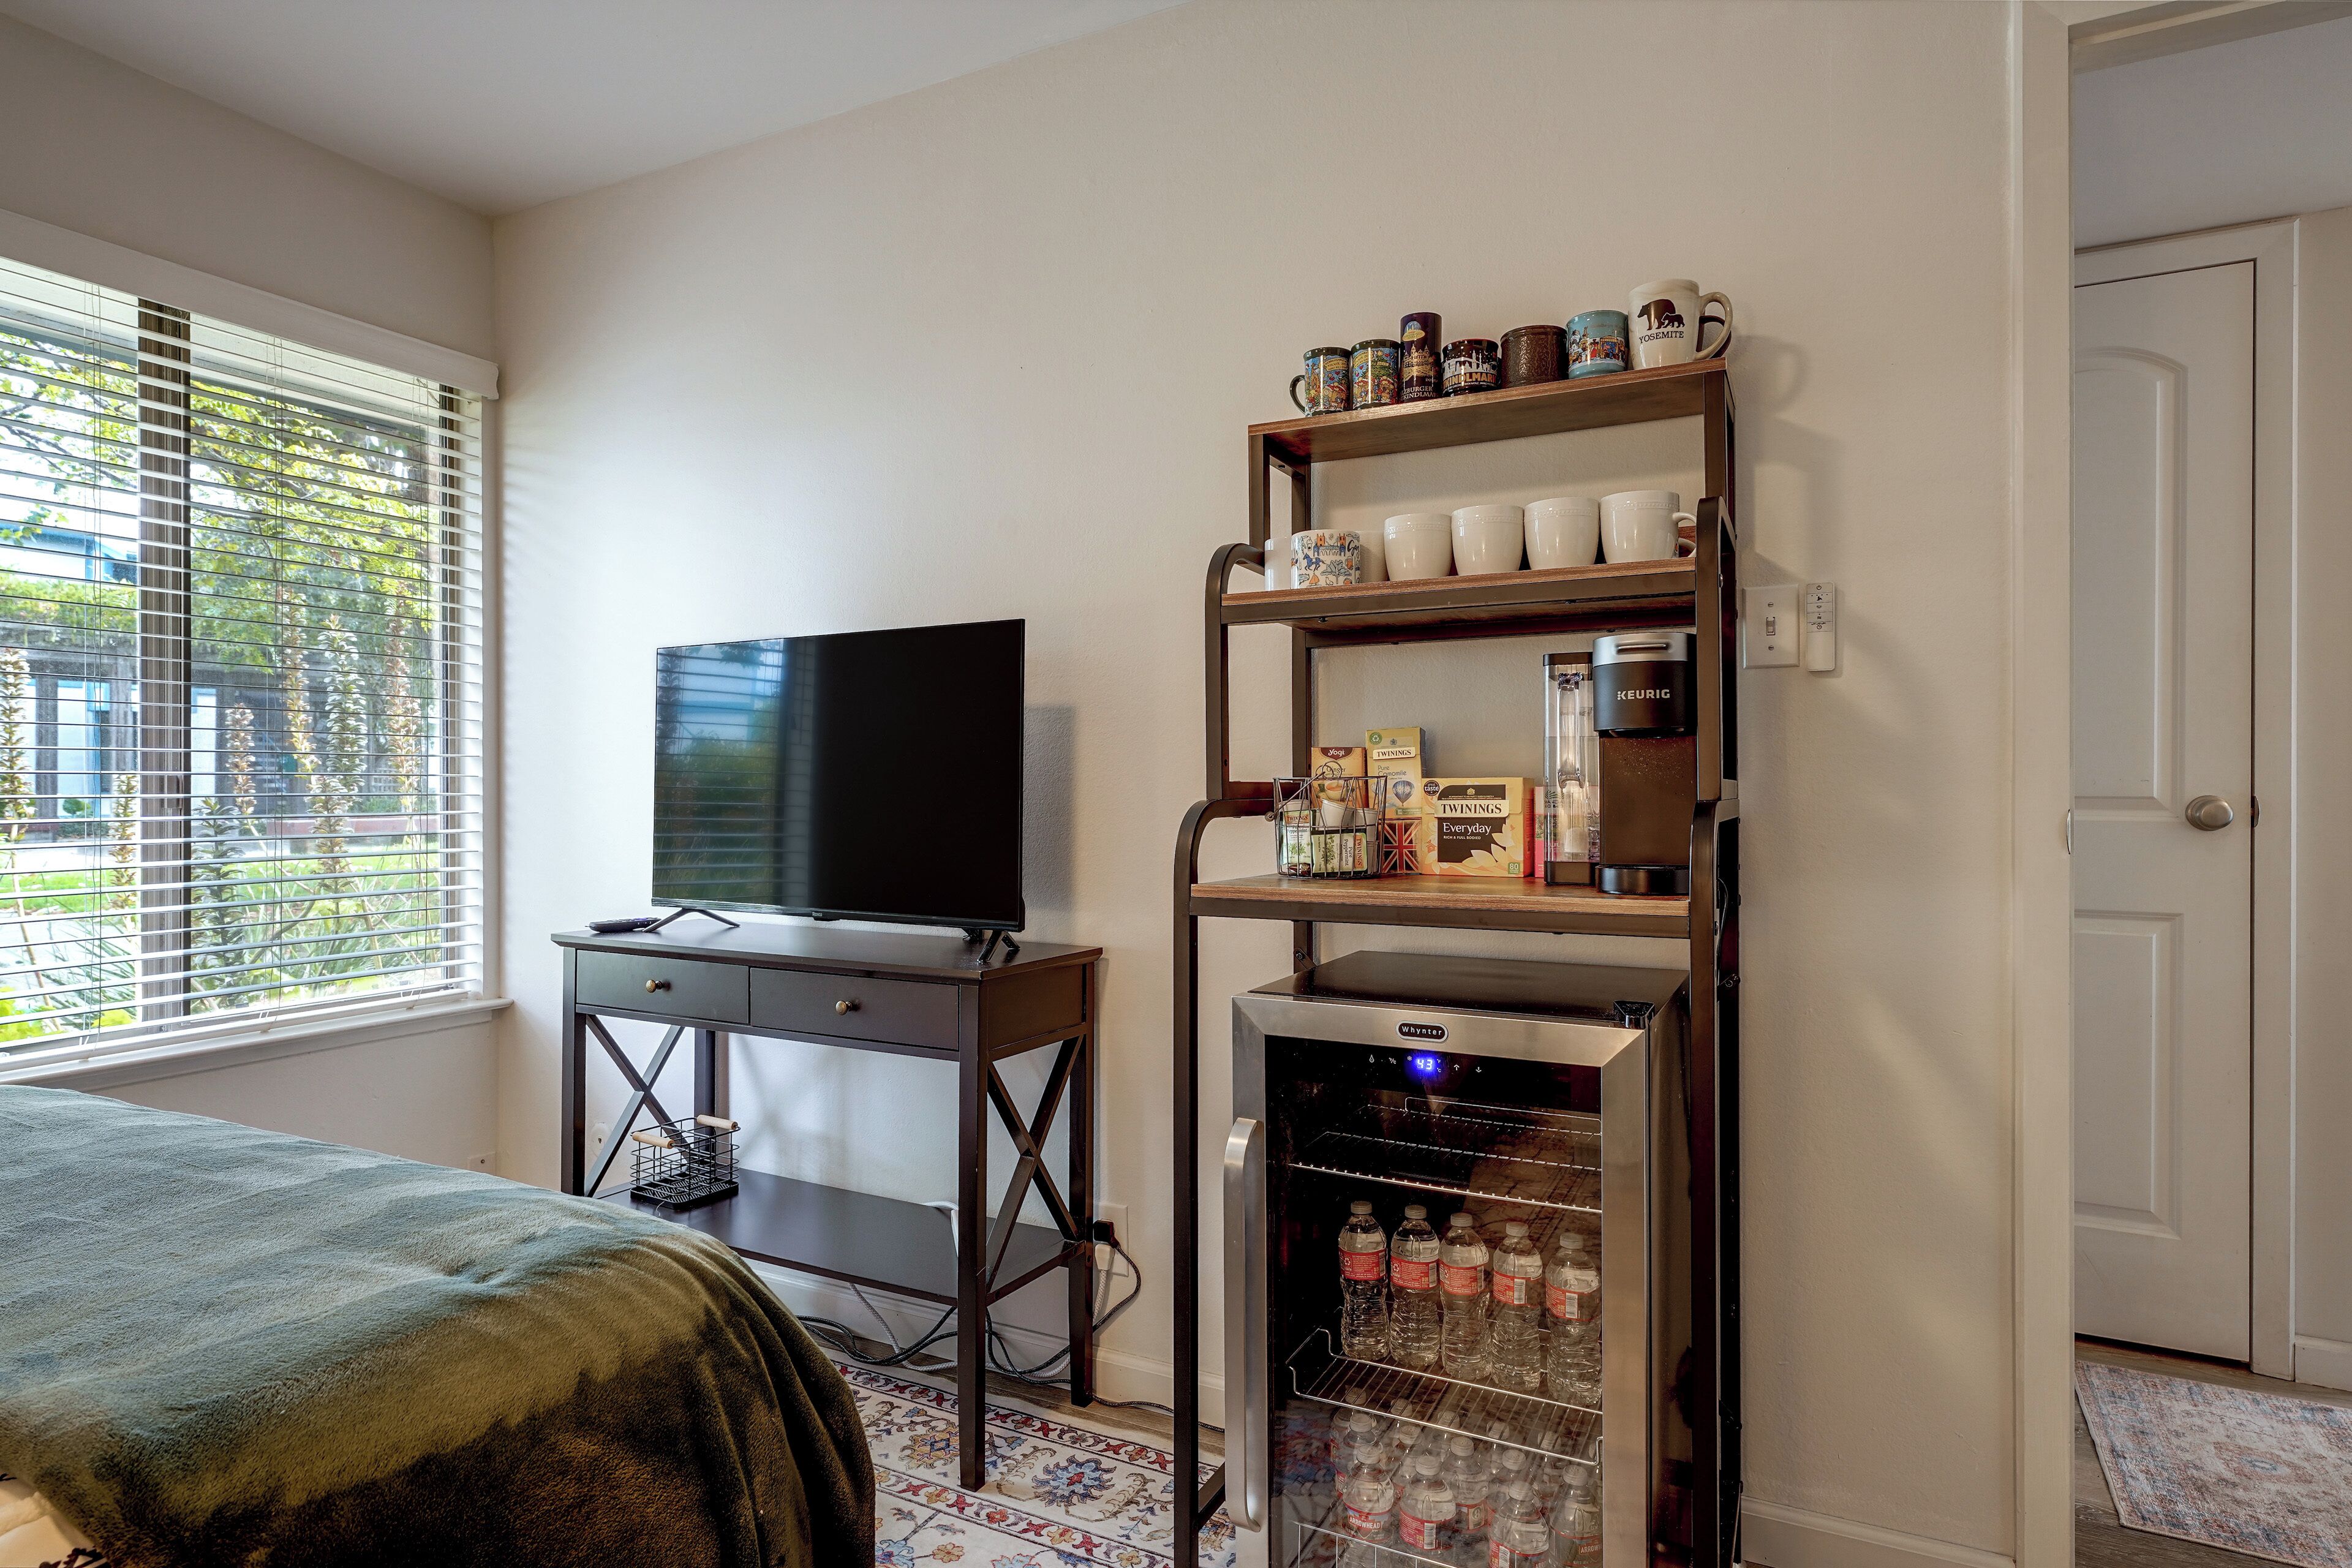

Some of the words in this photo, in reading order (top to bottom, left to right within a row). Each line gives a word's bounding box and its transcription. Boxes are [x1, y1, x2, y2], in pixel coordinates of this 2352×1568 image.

[1639, 331, 1684, 344] YOSEMITE
[1617, 689, 1670, 700] KEURIG
[1377, 749, 1411, 758] TWININGS
[1441, 803, 1502, 813] TWININGS
[1443, 823, 1491, 835] Everyday
[1401, 1026, 1442, 1035] Whynter
[1417, 1059, 1433, 1070] 43
[1349, 1516, 1381, 1529] ARROWHEAD
